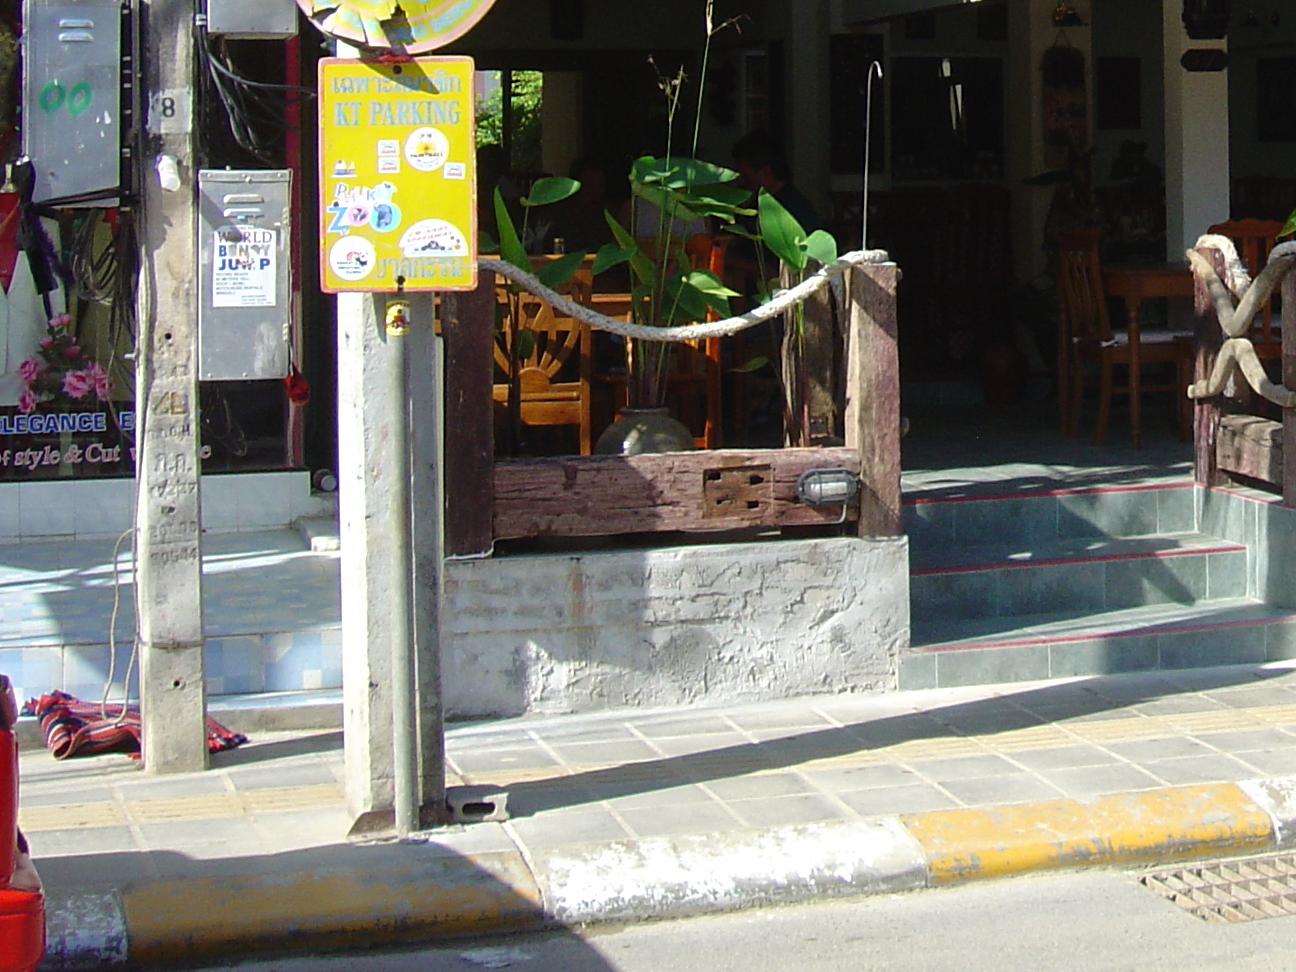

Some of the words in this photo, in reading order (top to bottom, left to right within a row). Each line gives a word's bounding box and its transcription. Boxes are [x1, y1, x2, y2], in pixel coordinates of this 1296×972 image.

[161, 96, 176, 119] 8
[334, 101, 363, 127] KT
[367, 99, 461, 126] PARKING
[217, 230, 273, 244] WRLD
[217, 257, 271, 271] JUP
[0, 412, 107, 435] LEGANCE
[14, 444, 61, 470] style
[63, 443, 83, 465] &
[85, 442, 121, 464] Cut
